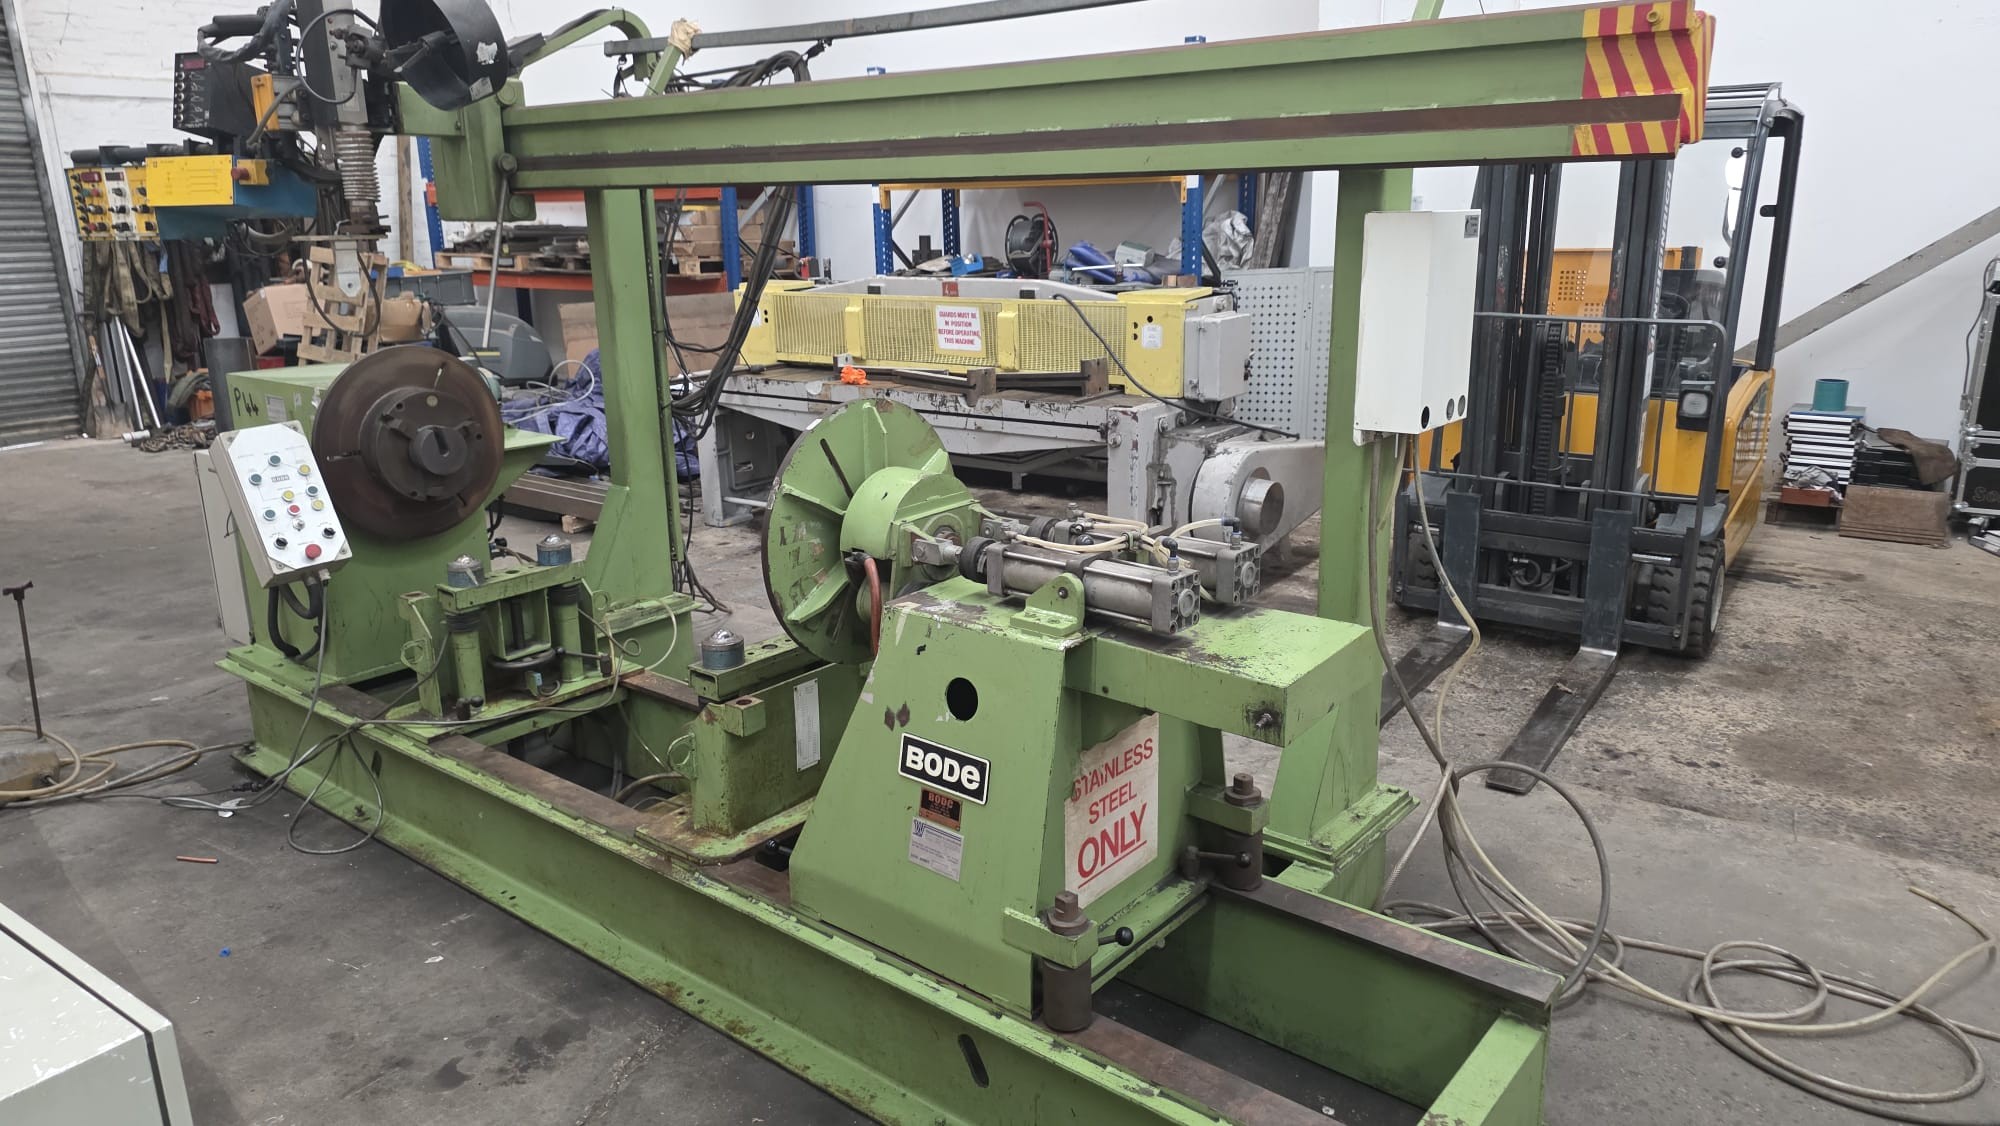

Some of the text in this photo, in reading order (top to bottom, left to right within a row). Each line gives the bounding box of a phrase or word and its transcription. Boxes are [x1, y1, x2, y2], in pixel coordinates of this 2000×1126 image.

[938, 328, 979, 337] BEFORE OPERATING
[1070, 738, 1154, 803] STAINLESS
[1088, 781, 1138, 825] STEEL
[1078, 802, 1148, 879] ONLY
